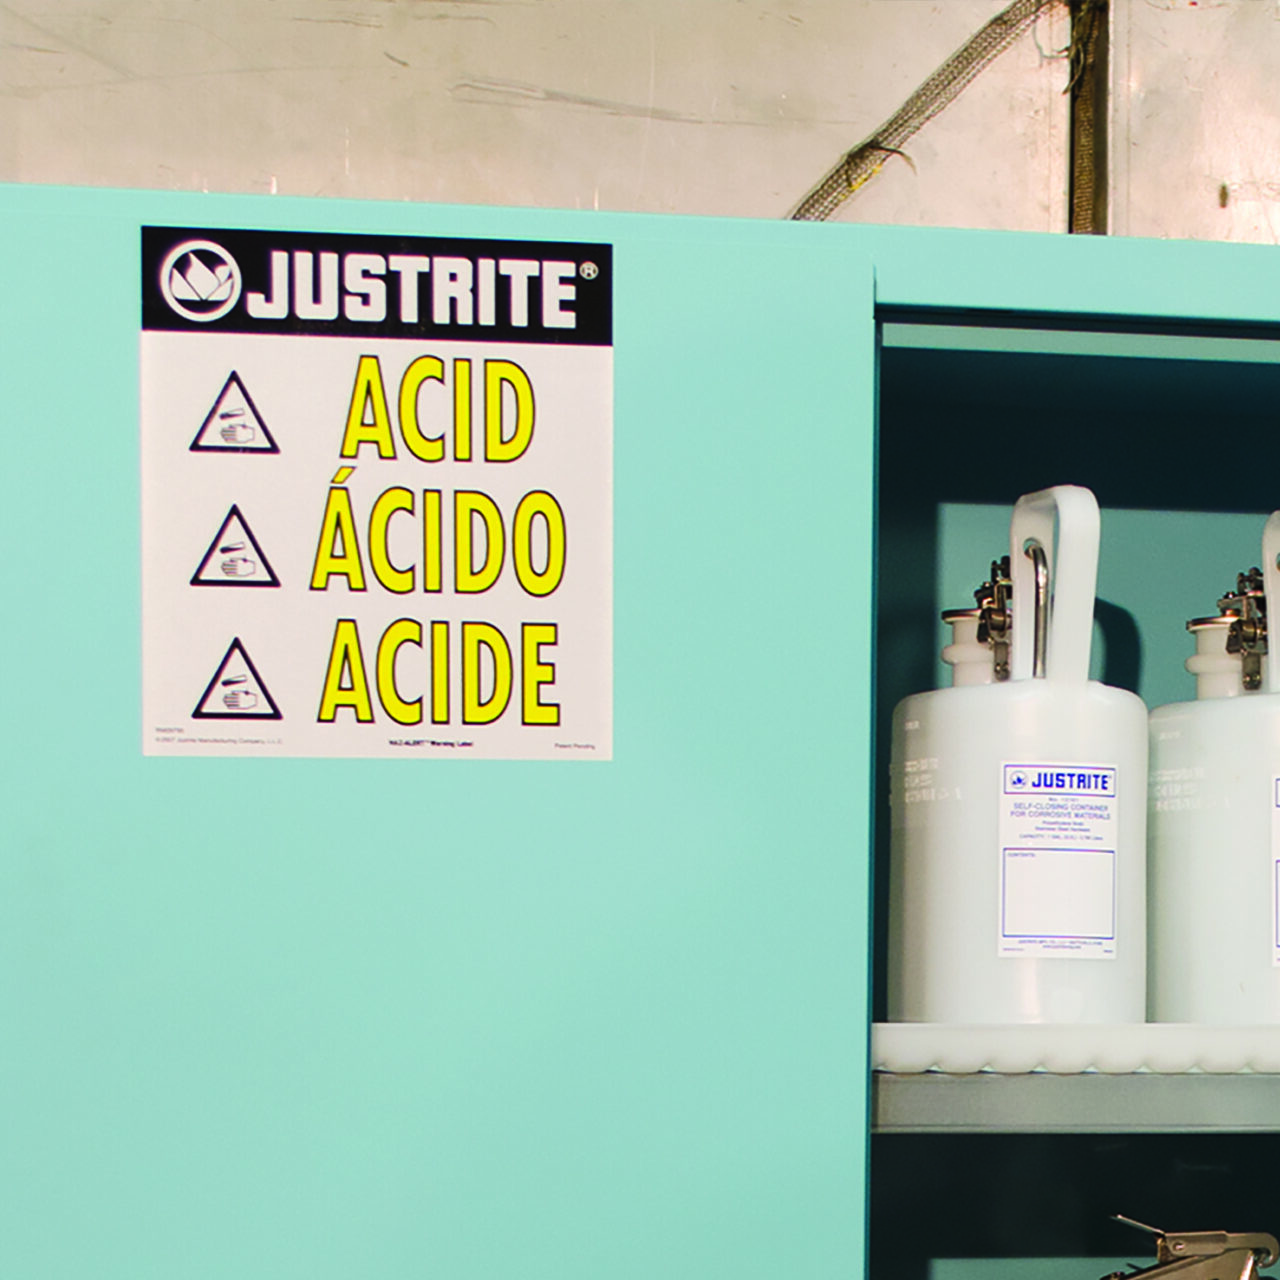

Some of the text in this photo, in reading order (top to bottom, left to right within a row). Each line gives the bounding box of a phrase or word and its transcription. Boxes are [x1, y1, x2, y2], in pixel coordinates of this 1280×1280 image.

[340, 354, 536, 462] ACID
[309, 466, 567, 598] ÁCIDO
[317, 618, 561, 726] ACIDE
[1013, 802, 1109, 812] SELF-CLOSING CONTAINER
[1028, 810, 1072, 818] CORROSIVE
[1073, 811, 1111, 820] MATERIALS
